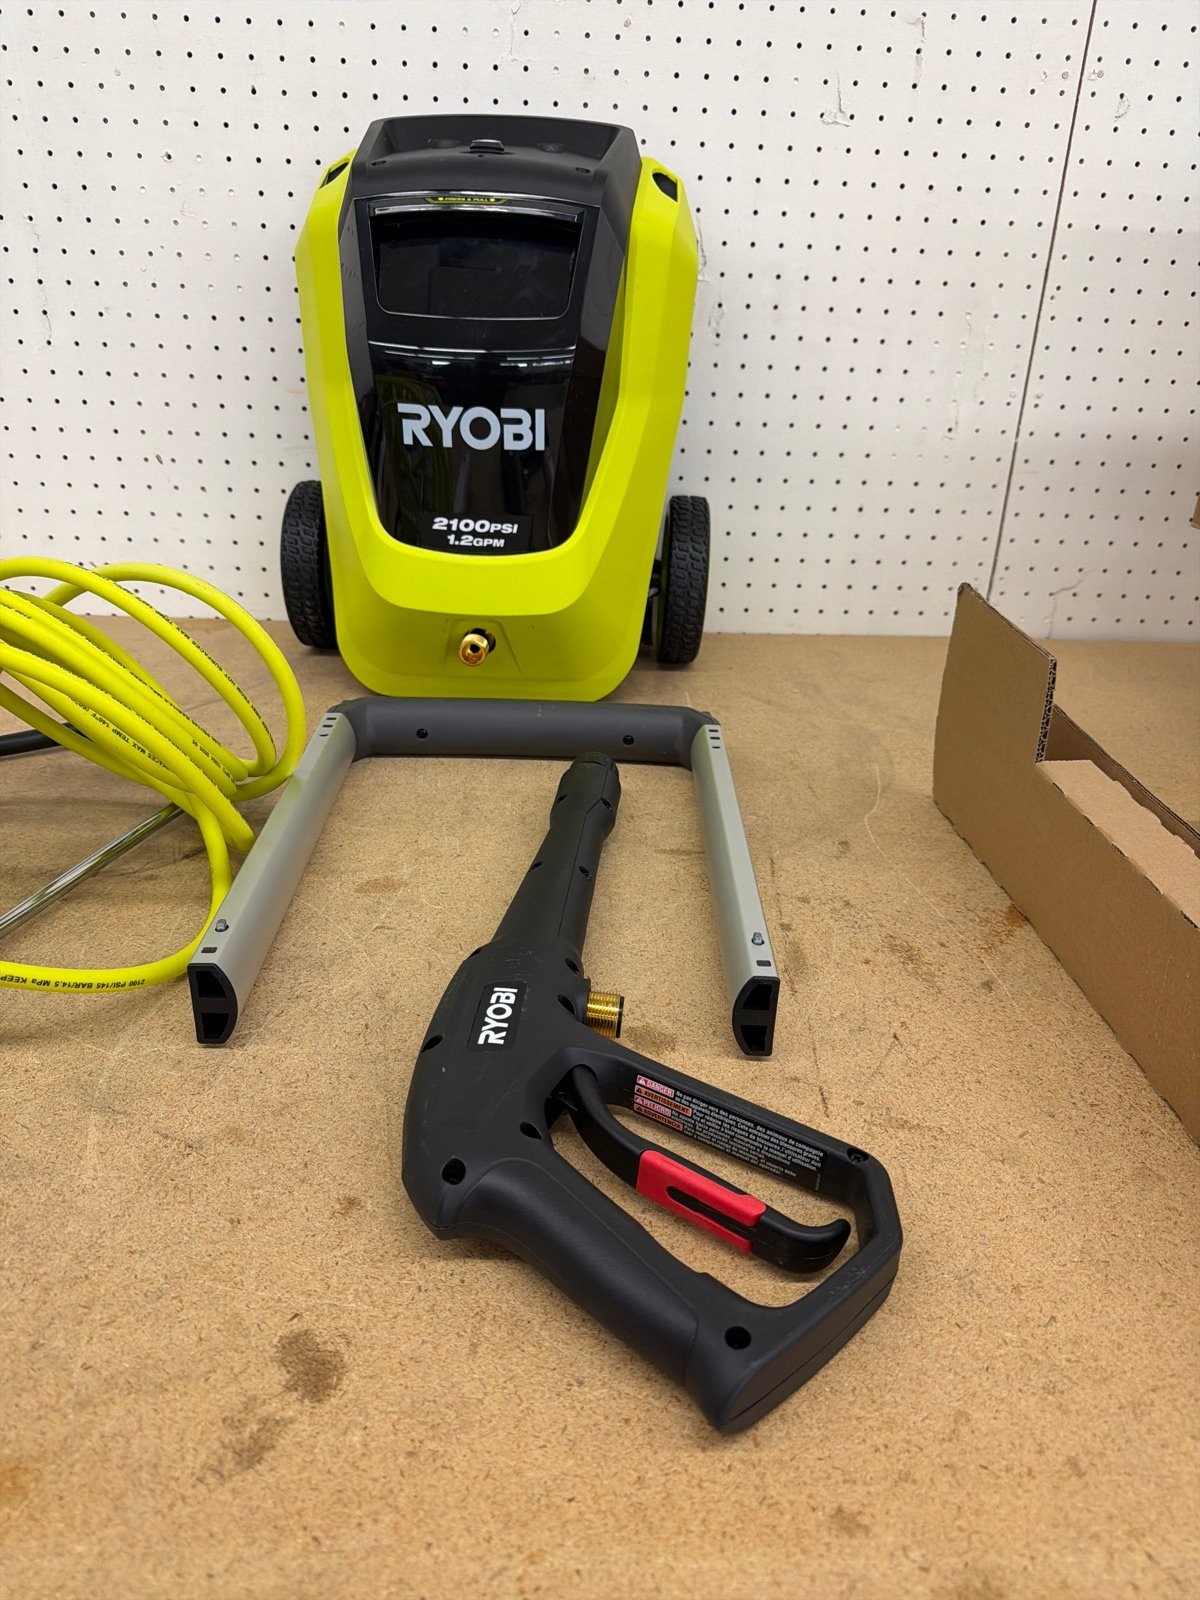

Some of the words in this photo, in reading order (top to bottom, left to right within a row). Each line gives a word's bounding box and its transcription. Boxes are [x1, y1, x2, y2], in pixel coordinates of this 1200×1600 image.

[397, 403, 546, 451] RYOBI
[432, 517, 518, 534] 2100PSI
[447, 535, 505, 547] 1.2GPM
[112, 728, 130, 744] TEMP
[132, 743, 146, 754] MAX
[0, 974, 27, 984] KEEP
[54, 981, 93, 989] BAR/14.5
[96, 981, 126, 989] PSI/145
[478, 987, 518, 1044] RYOBI
